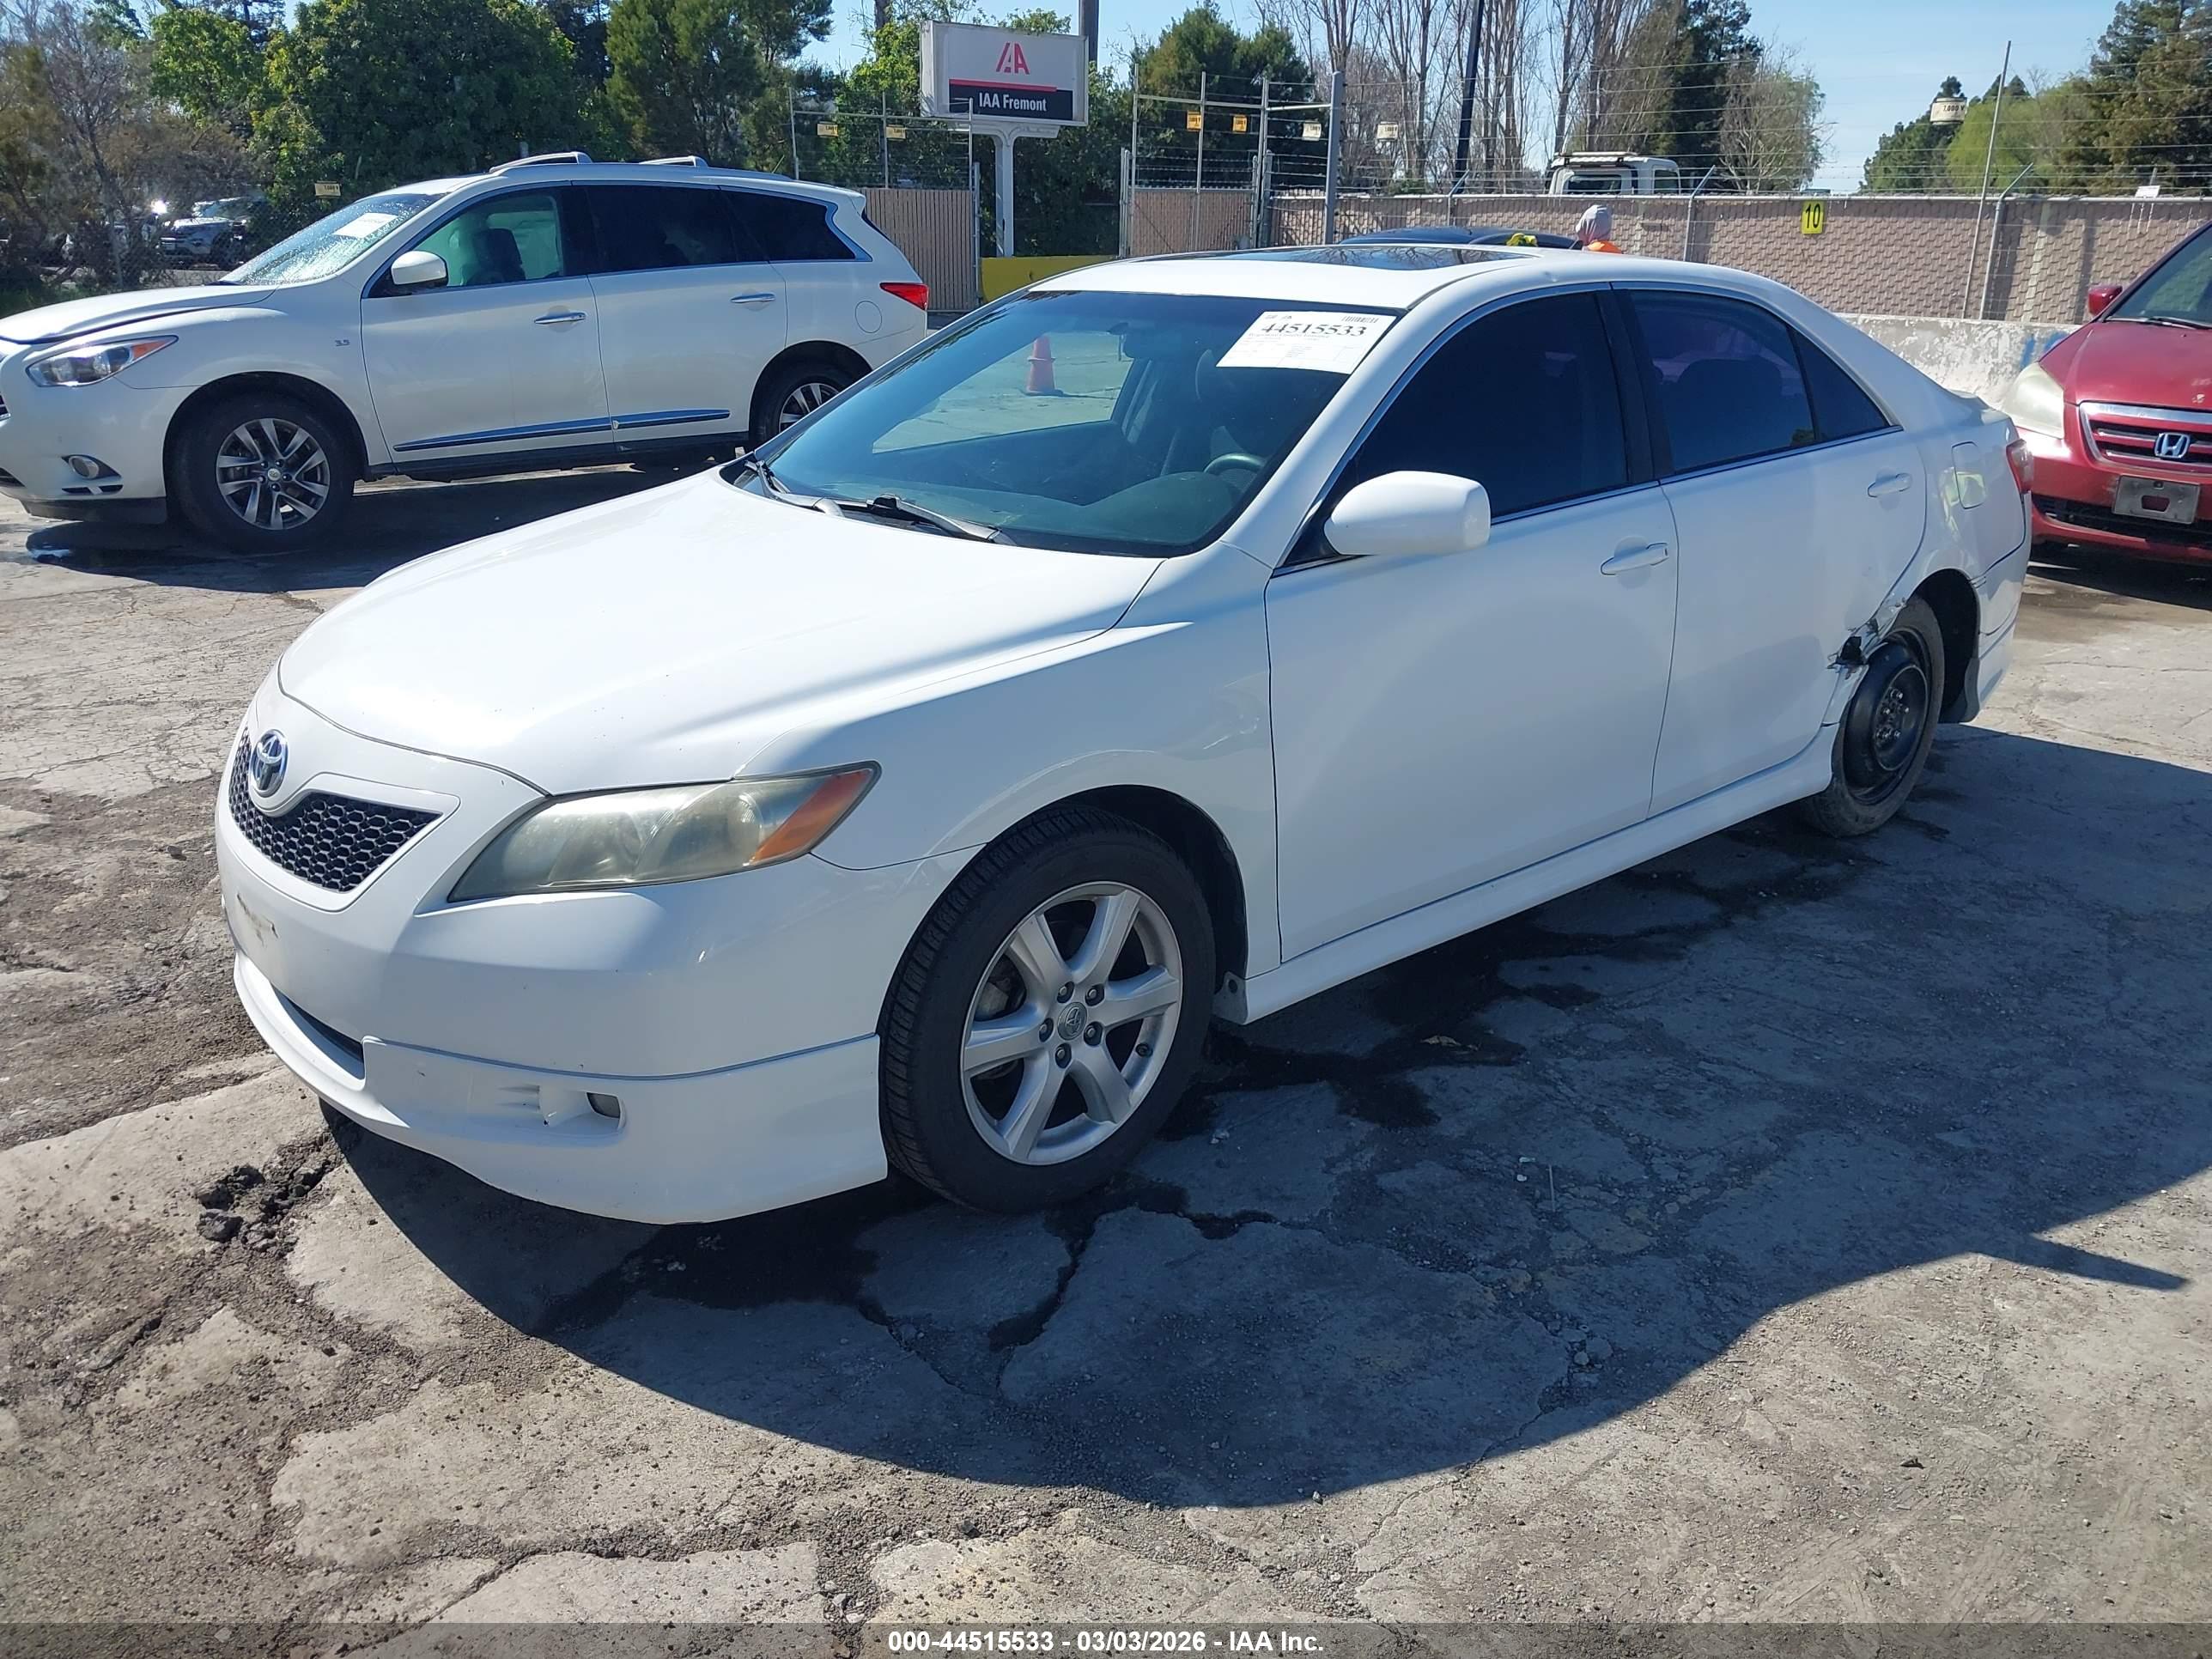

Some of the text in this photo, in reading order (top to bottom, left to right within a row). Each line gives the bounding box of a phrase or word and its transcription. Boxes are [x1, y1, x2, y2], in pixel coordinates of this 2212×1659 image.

[979, 92, 1047, 112] IAA Fremont
[1806, 204, 1820, 228] 10
[1261, 323, 1367, 337] 44515533
